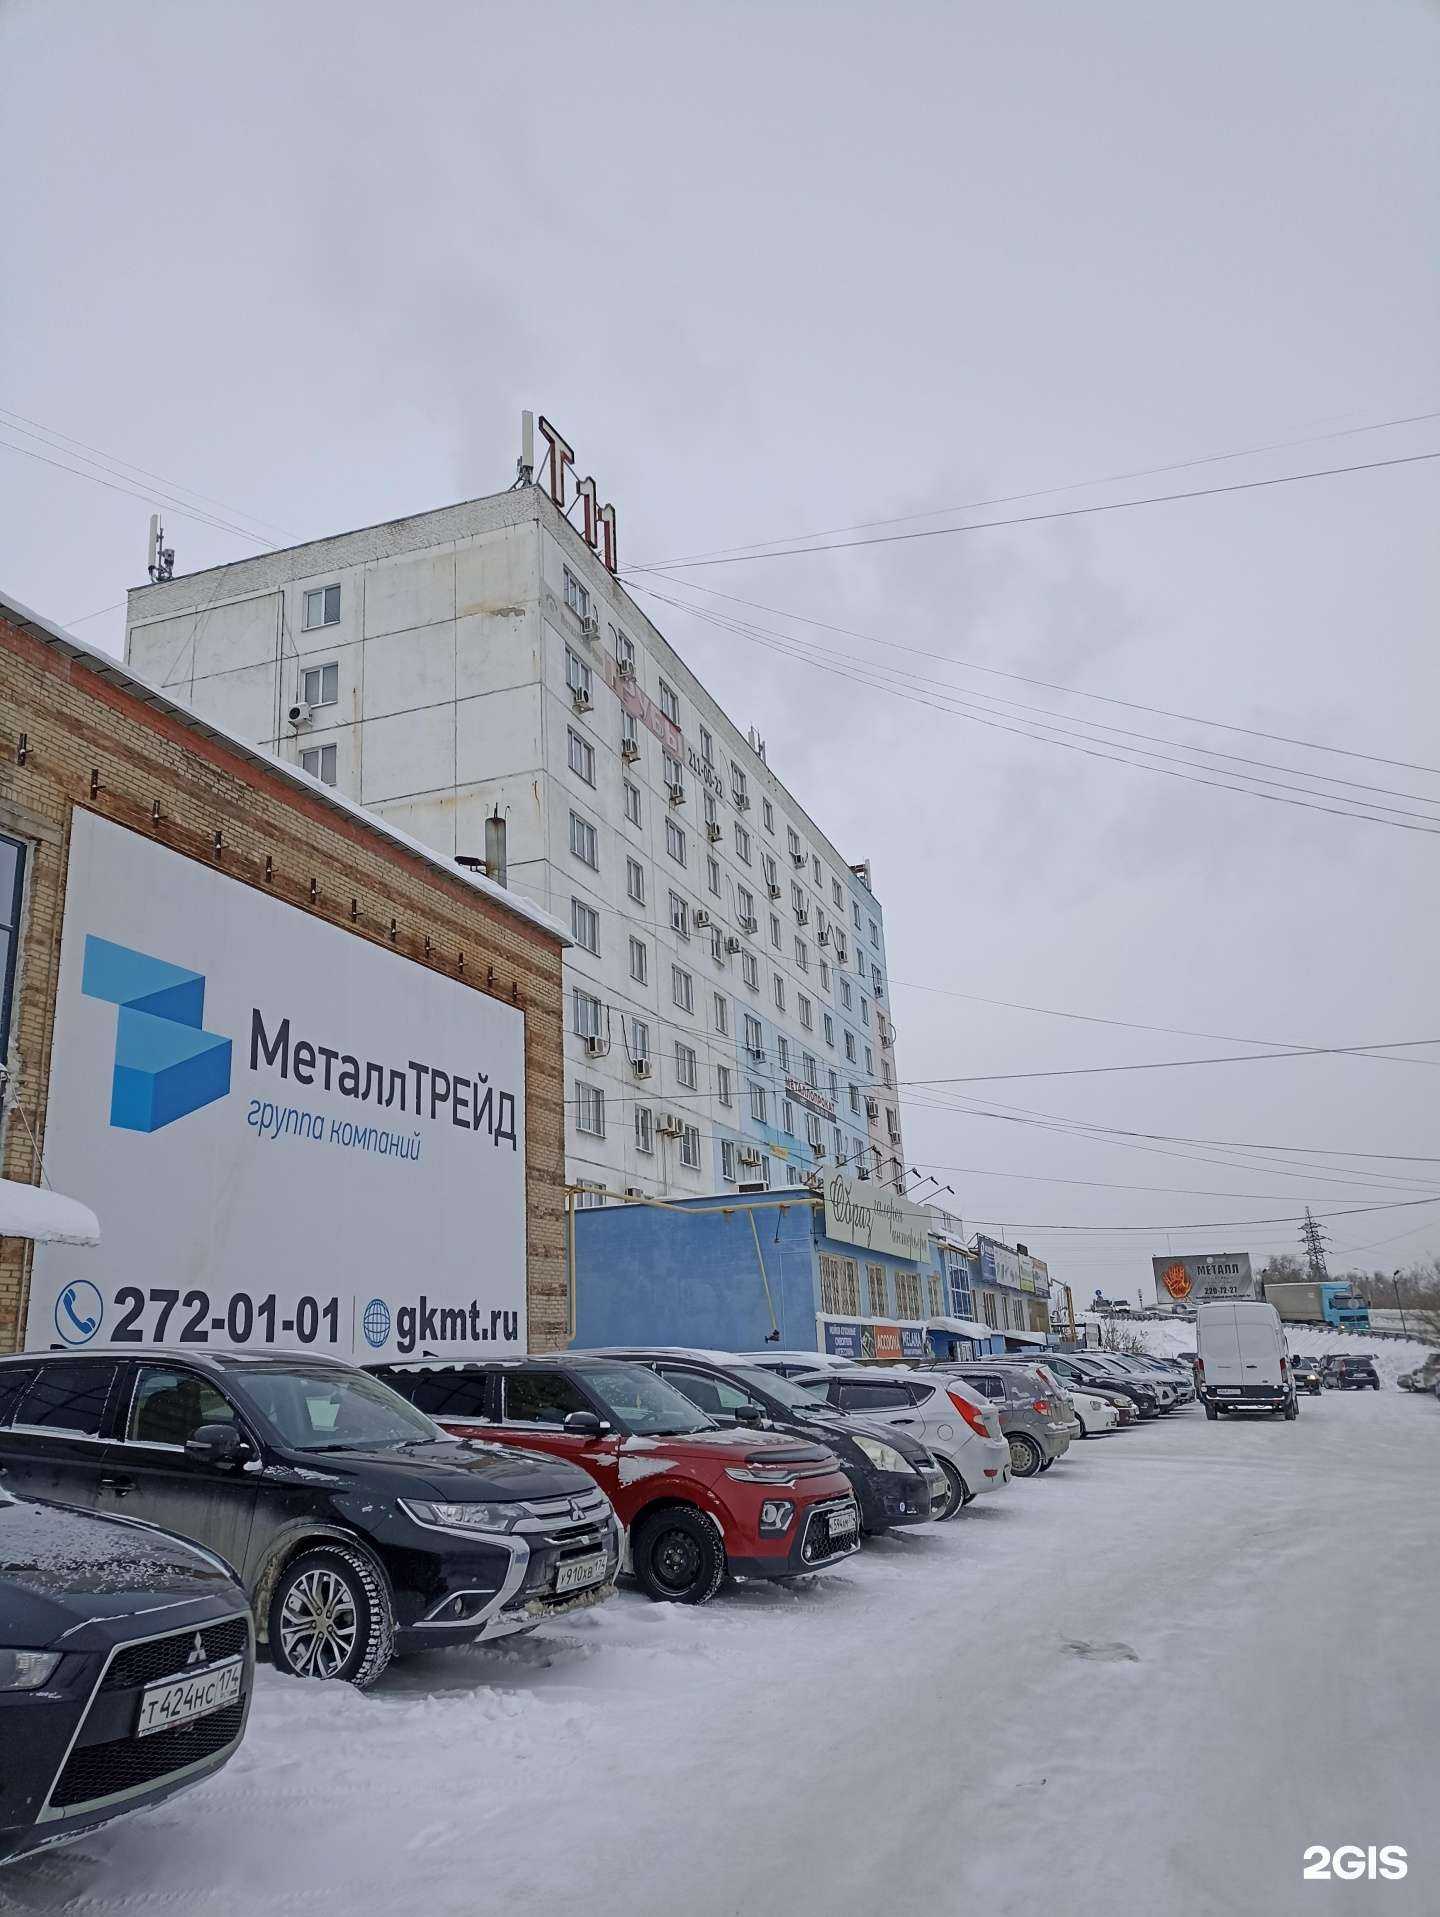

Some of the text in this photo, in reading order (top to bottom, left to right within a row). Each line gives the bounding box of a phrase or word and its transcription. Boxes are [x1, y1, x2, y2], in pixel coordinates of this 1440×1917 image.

[688, 747, 723, 799] 211-00-22
[249, 1007, 518, 1152] МеталлТРЕЙД
[246, 1099, 422, 1162] группа компаний
[1197, 1263, 1240, 1276] МЕТАЛЛ
[110, 1285, 519, 1354] 272-01-01 gkmt.ru
